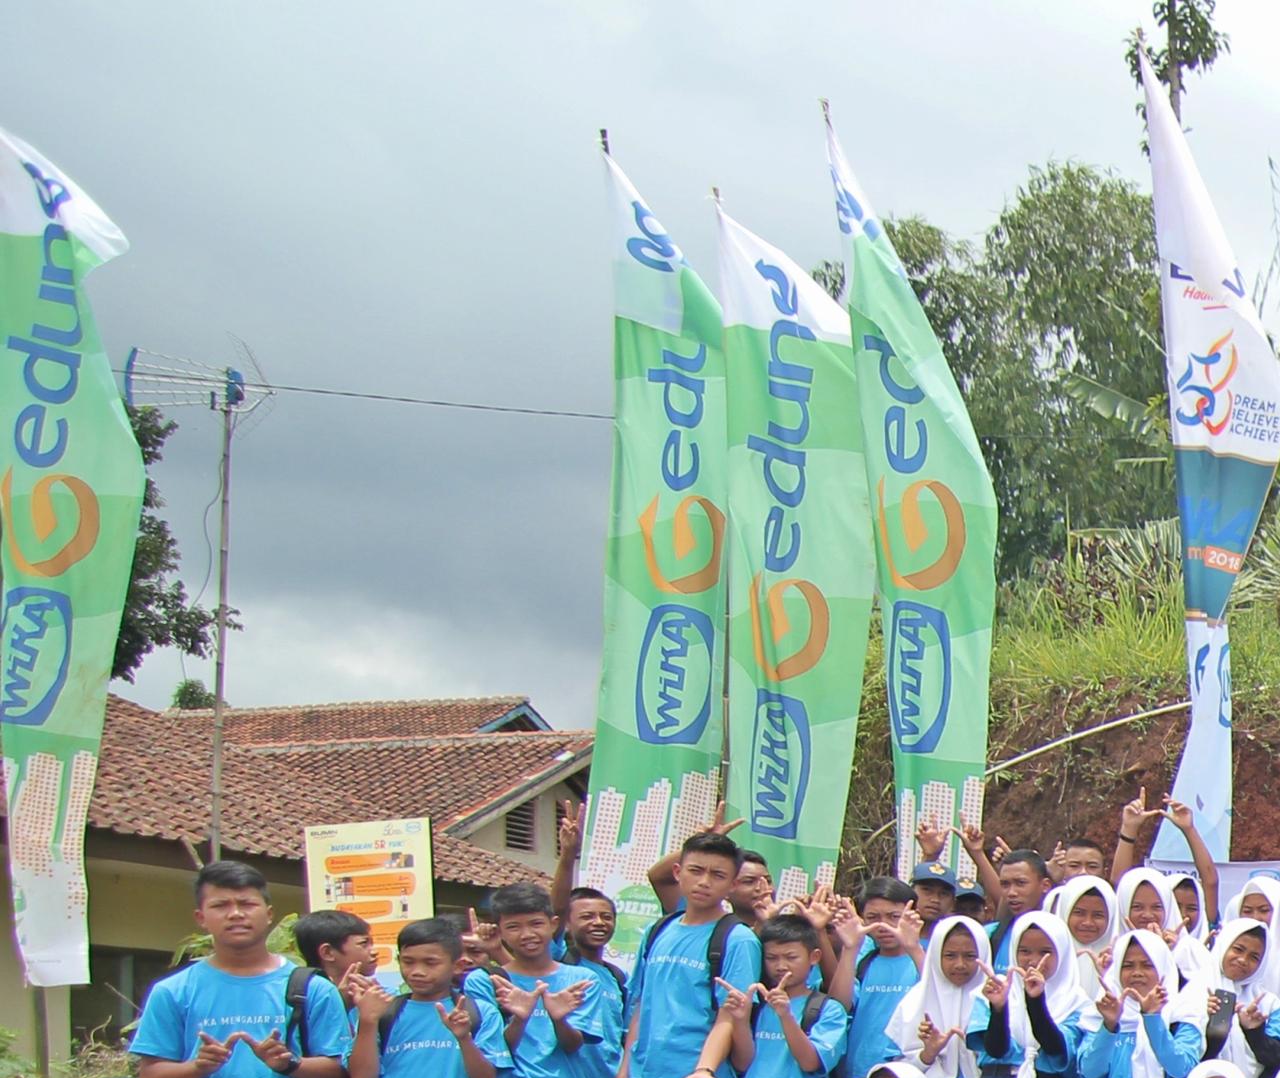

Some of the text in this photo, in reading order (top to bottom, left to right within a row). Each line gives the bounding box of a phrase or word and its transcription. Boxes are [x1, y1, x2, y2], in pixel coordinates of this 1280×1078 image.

[374, 840, 386, 848] 5R
[221, 1014, 271, 1026] MENGAJAR
[403, 1040, 453, 1050] MENGAJAR
